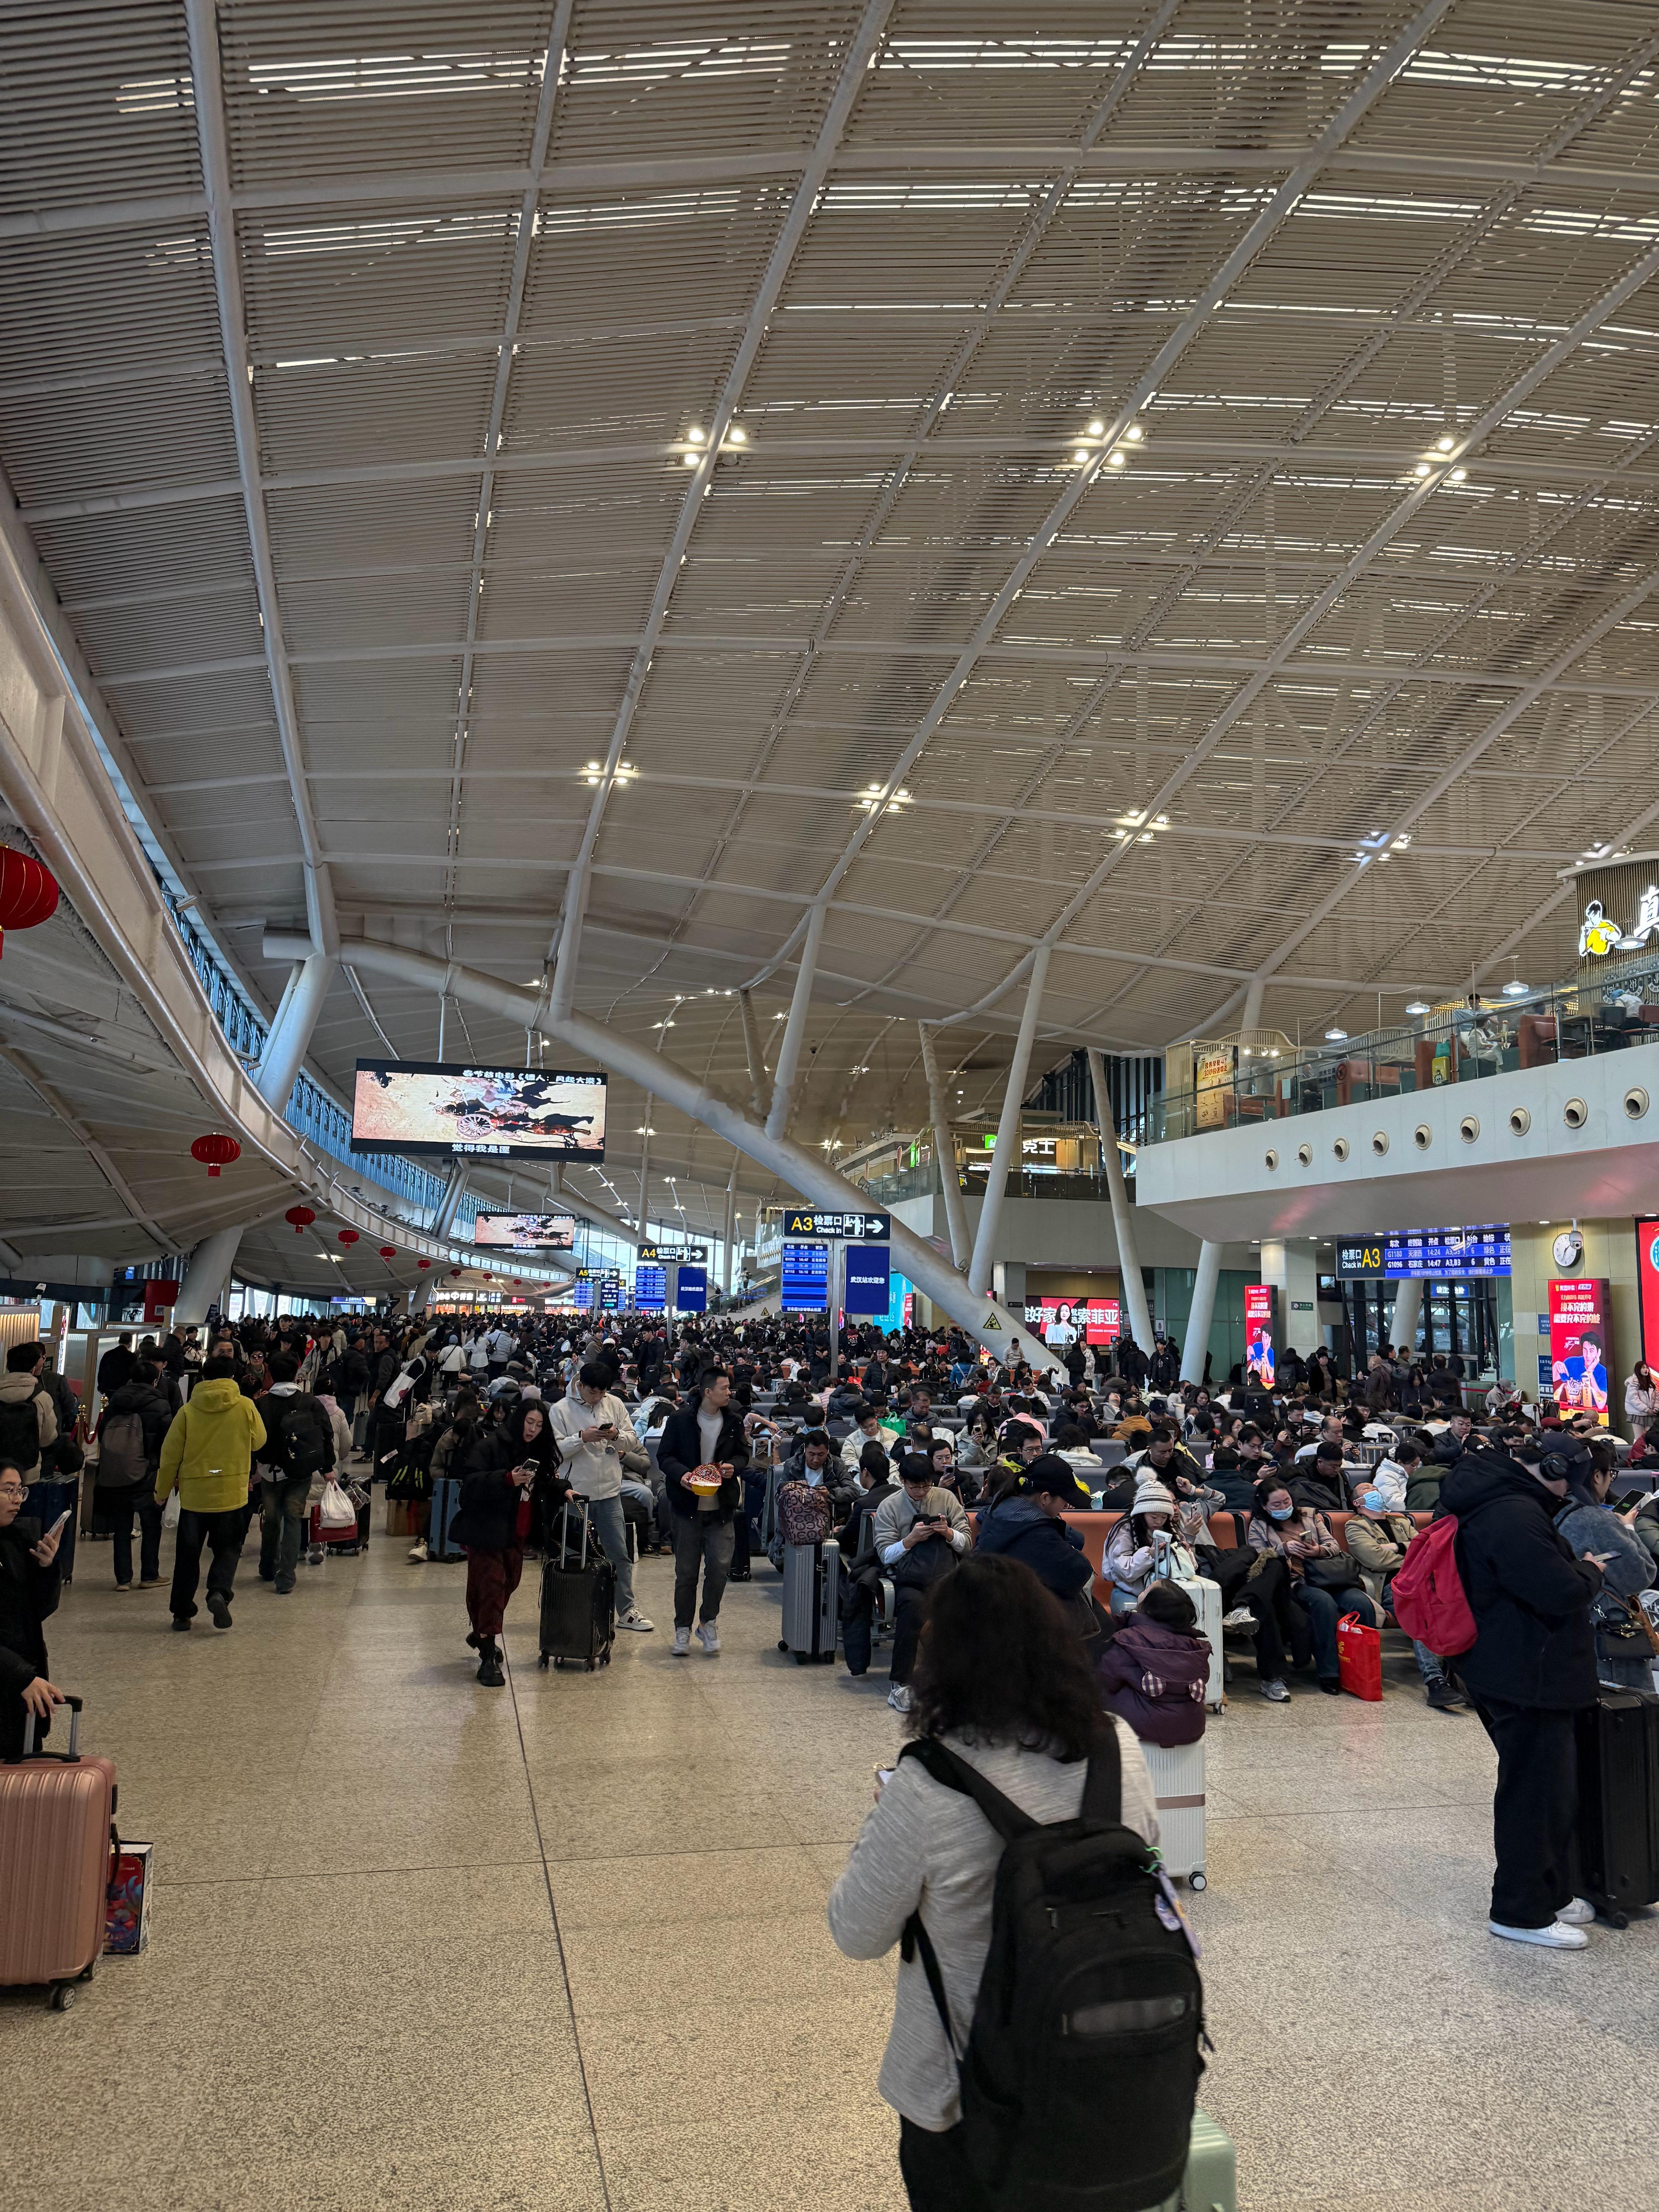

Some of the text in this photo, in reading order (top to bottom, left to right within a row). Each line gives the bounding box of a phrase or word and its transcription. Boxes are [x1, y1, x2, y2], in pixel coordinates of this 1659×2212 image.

[452, 1143, 510, 1154] 觉得我是匪
[791, 1217, 813, 1231] A3
[814, 1215, 842, 1226] 检票口
[1428, 1237, 1439, 1246] 开点
[642, 1248, 656, 1258] A4
[1342, 1249, 1361, 1260] 检票口
[1362, 1248, 1380, 1268] A3
[1078, 1308, 1118, 1324] 索菲亚
